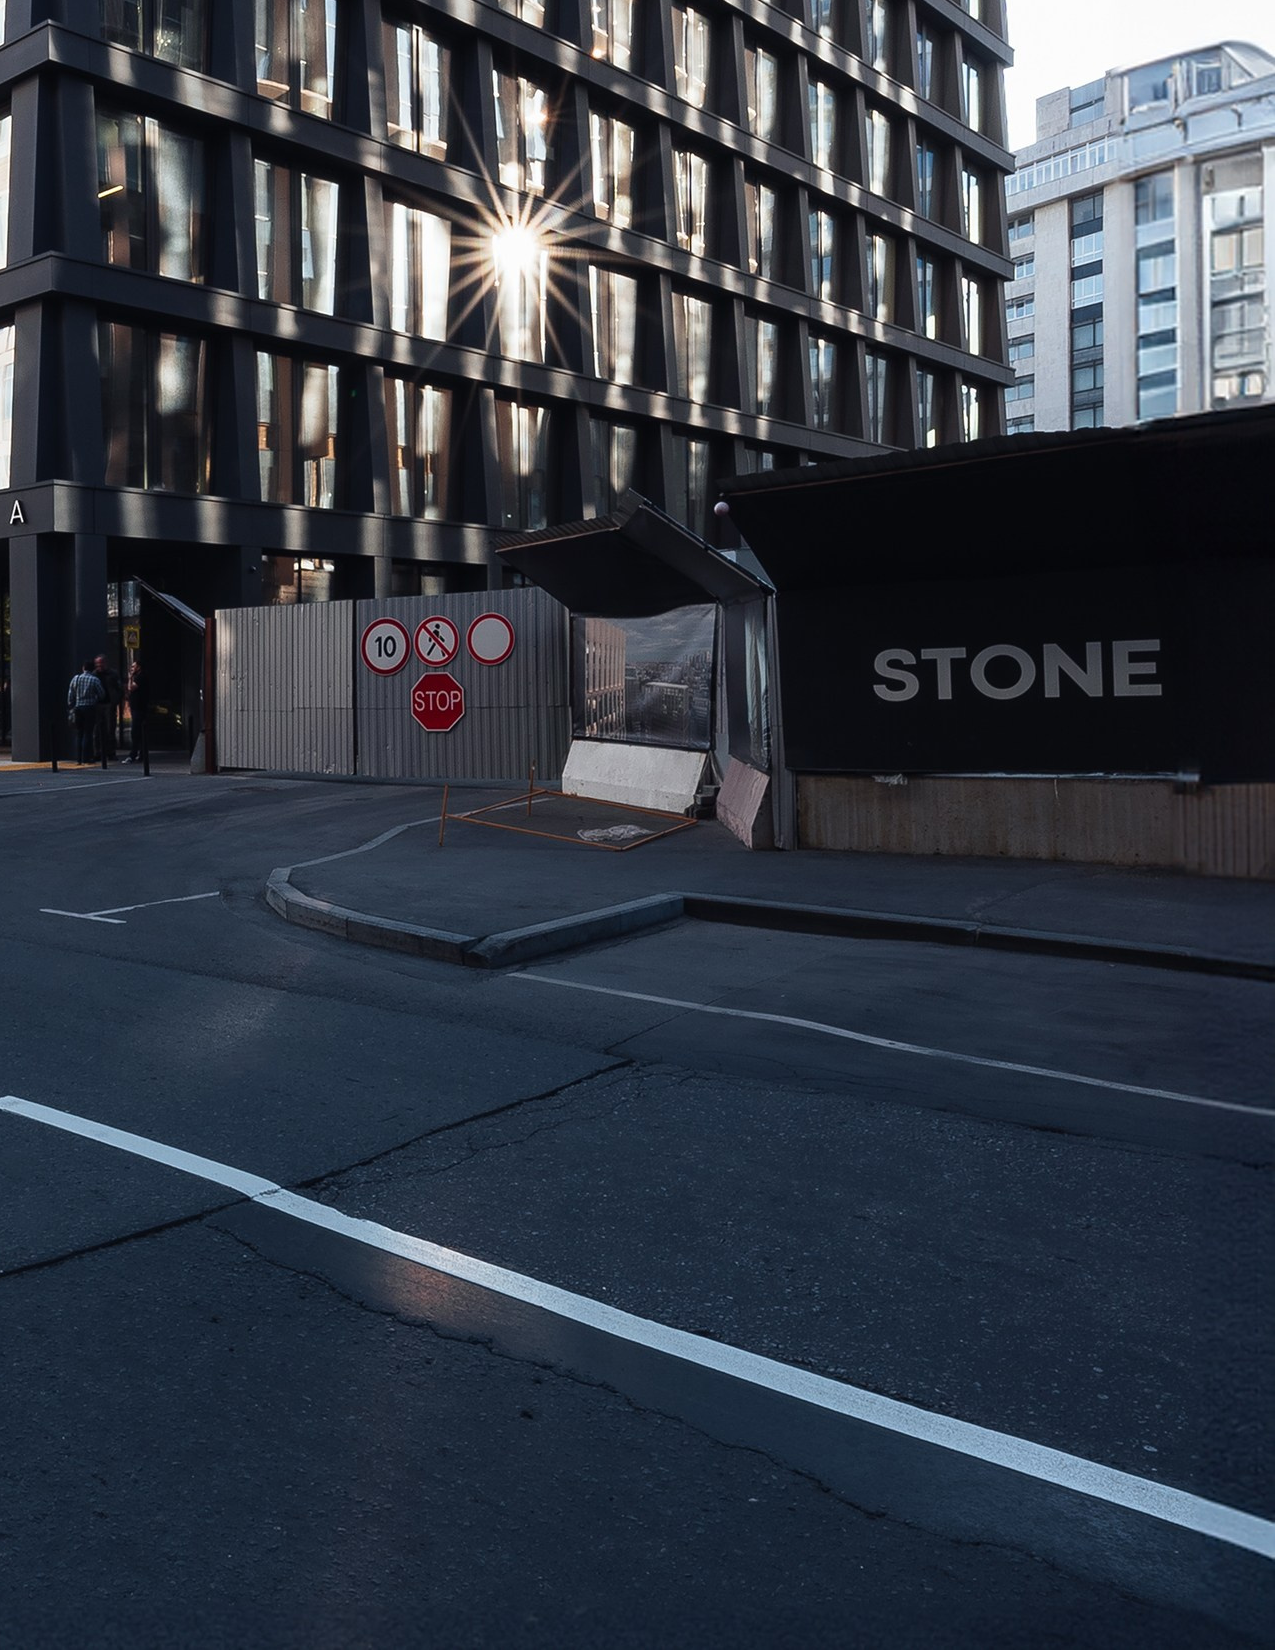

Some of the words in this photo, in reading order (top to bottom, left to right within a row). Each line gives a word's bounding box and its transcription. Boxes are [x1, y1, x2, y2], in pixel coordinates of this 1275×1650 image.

[9, 499, 24, 524] A
[374, 635, 397, 658] 10
[873, 639, 1162, 702] STONE
[414, 690, 461, 711] STOP
